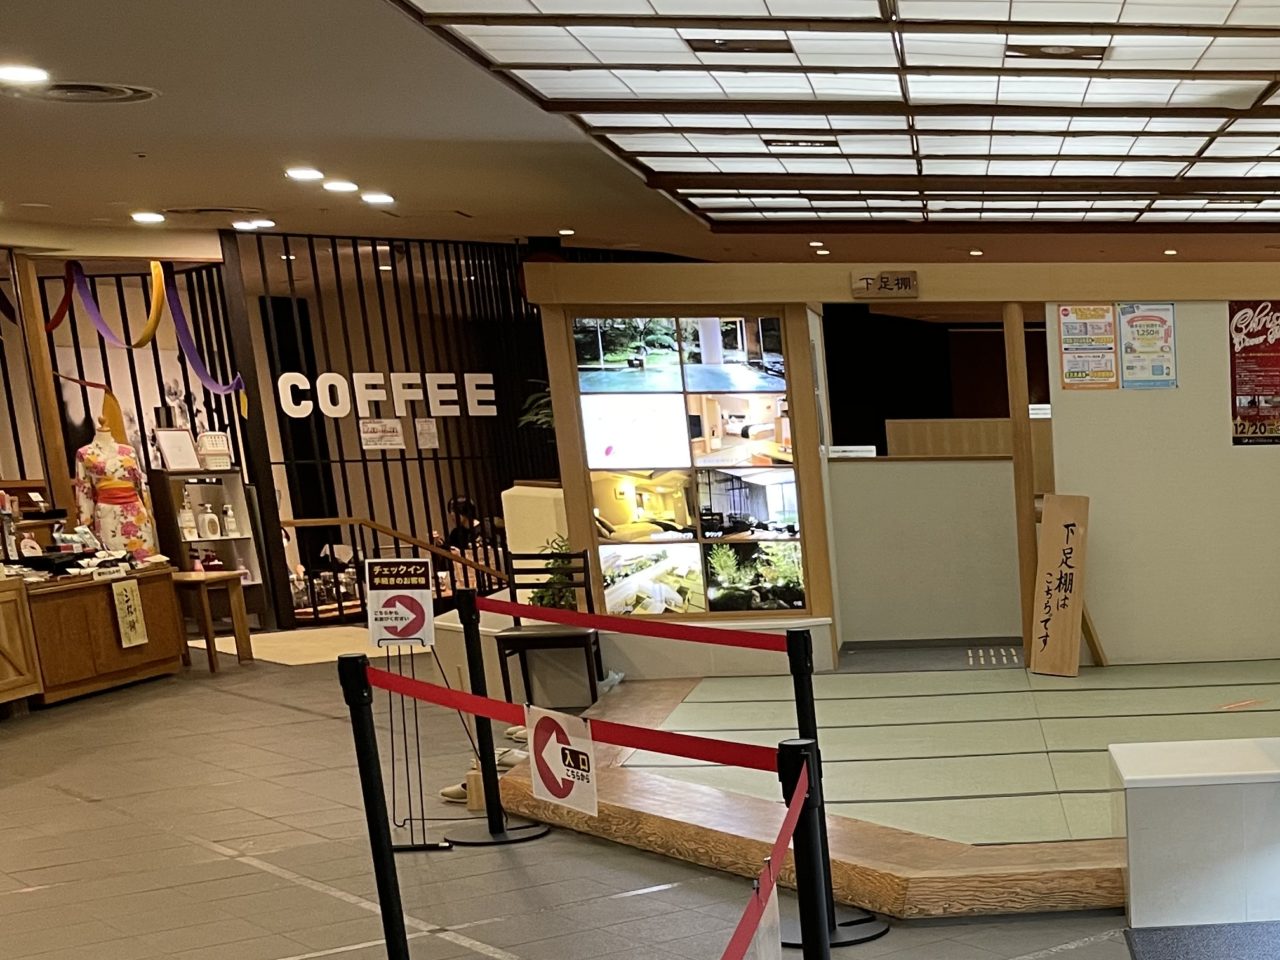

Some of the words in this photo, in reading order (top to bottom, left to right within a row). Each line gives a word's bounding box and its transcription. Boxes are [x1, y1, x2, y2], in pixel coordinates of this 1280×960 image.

[858, 276, 912, 291] 下足棚
[277, 372, 498, 418] COFFEE
[1233, 423, 1267, 435] 12/20
[373, 565, 425, 575] チェックイン
[1054, 522, 1077, 611] 下足棚は
[565, 750, 589, 771] 入口
